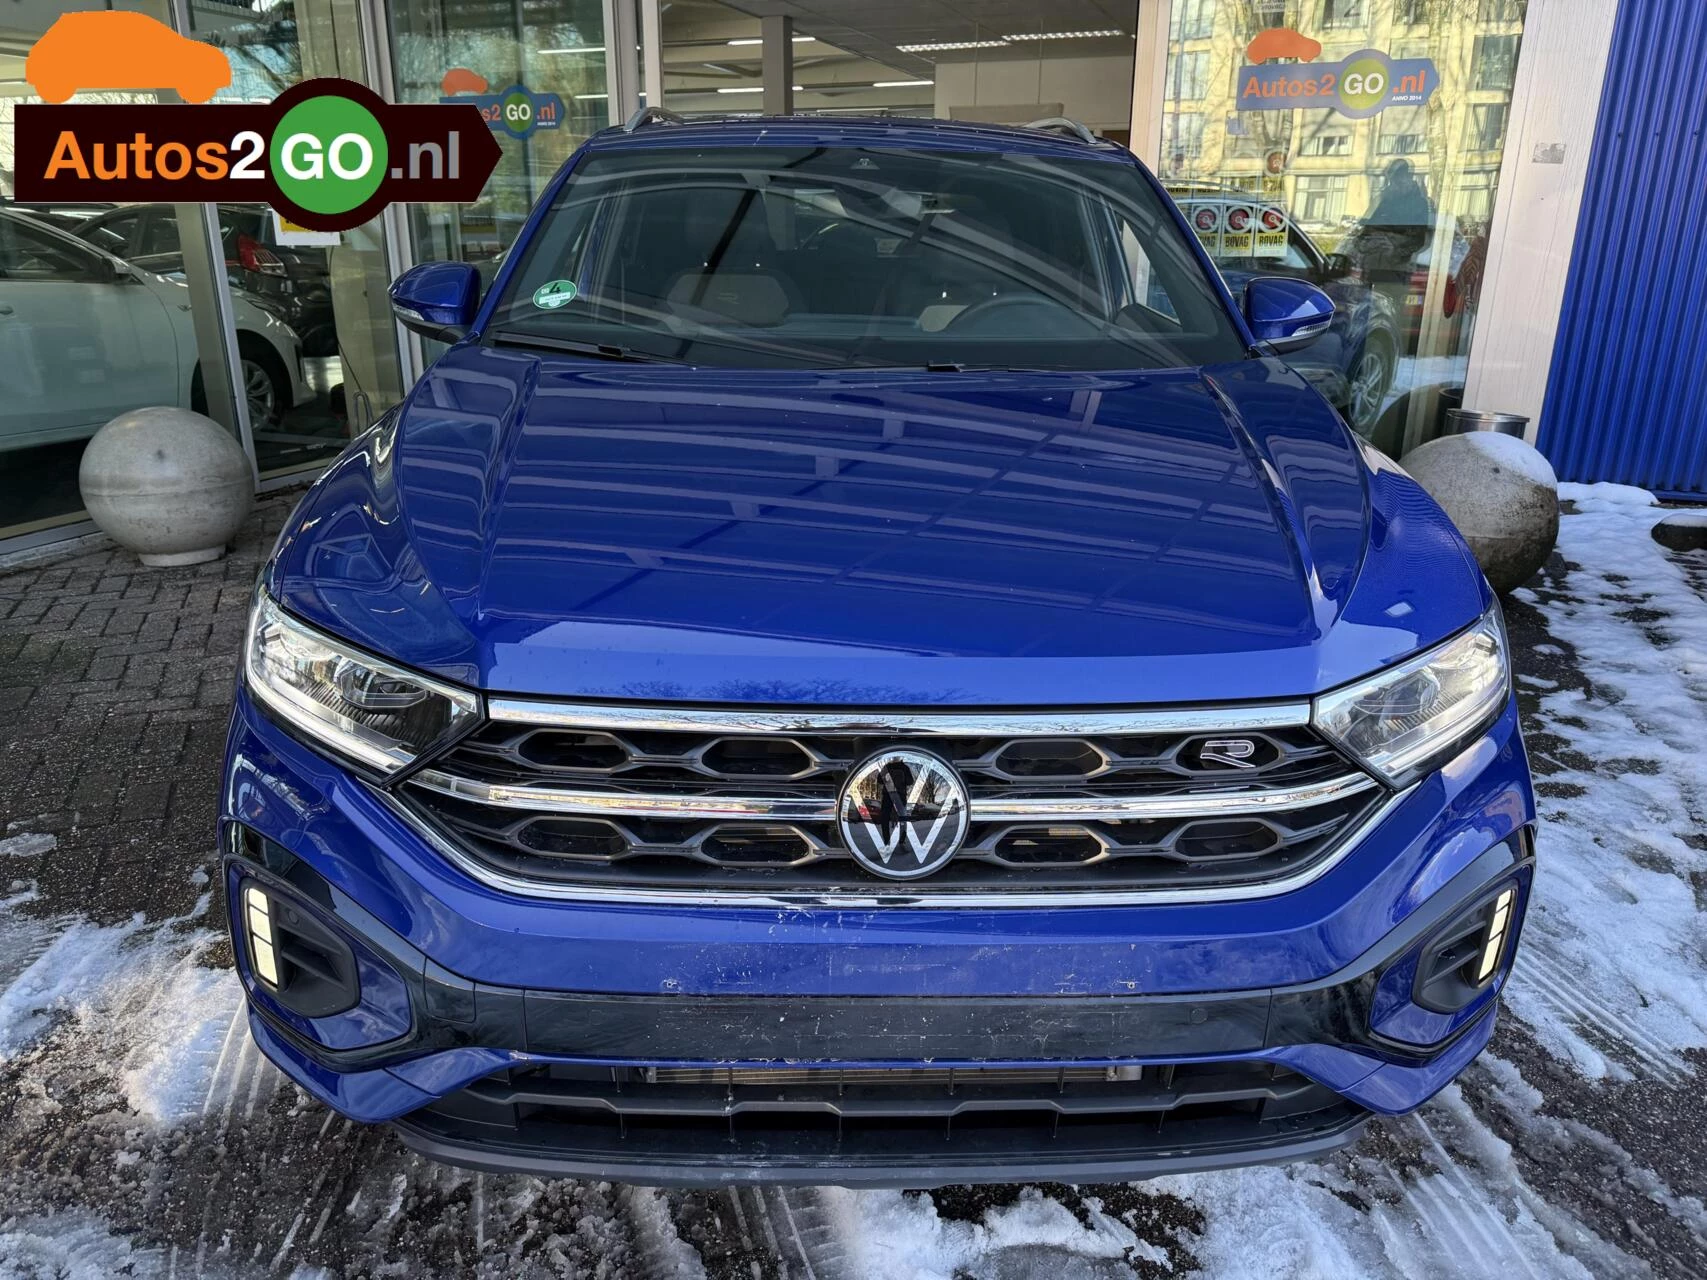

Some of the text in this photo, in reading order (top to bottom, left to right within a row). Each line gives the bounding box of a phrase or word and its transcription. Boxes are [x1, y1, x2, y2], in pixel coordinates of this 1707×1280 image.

[1243, 70, 1426, 98] Autos2GO.nl
[1225, 235, 1249, 248] BOVAG
[1259, 235, 1284, 247] BOVAG
[1200, 740, 1256, 767] R
